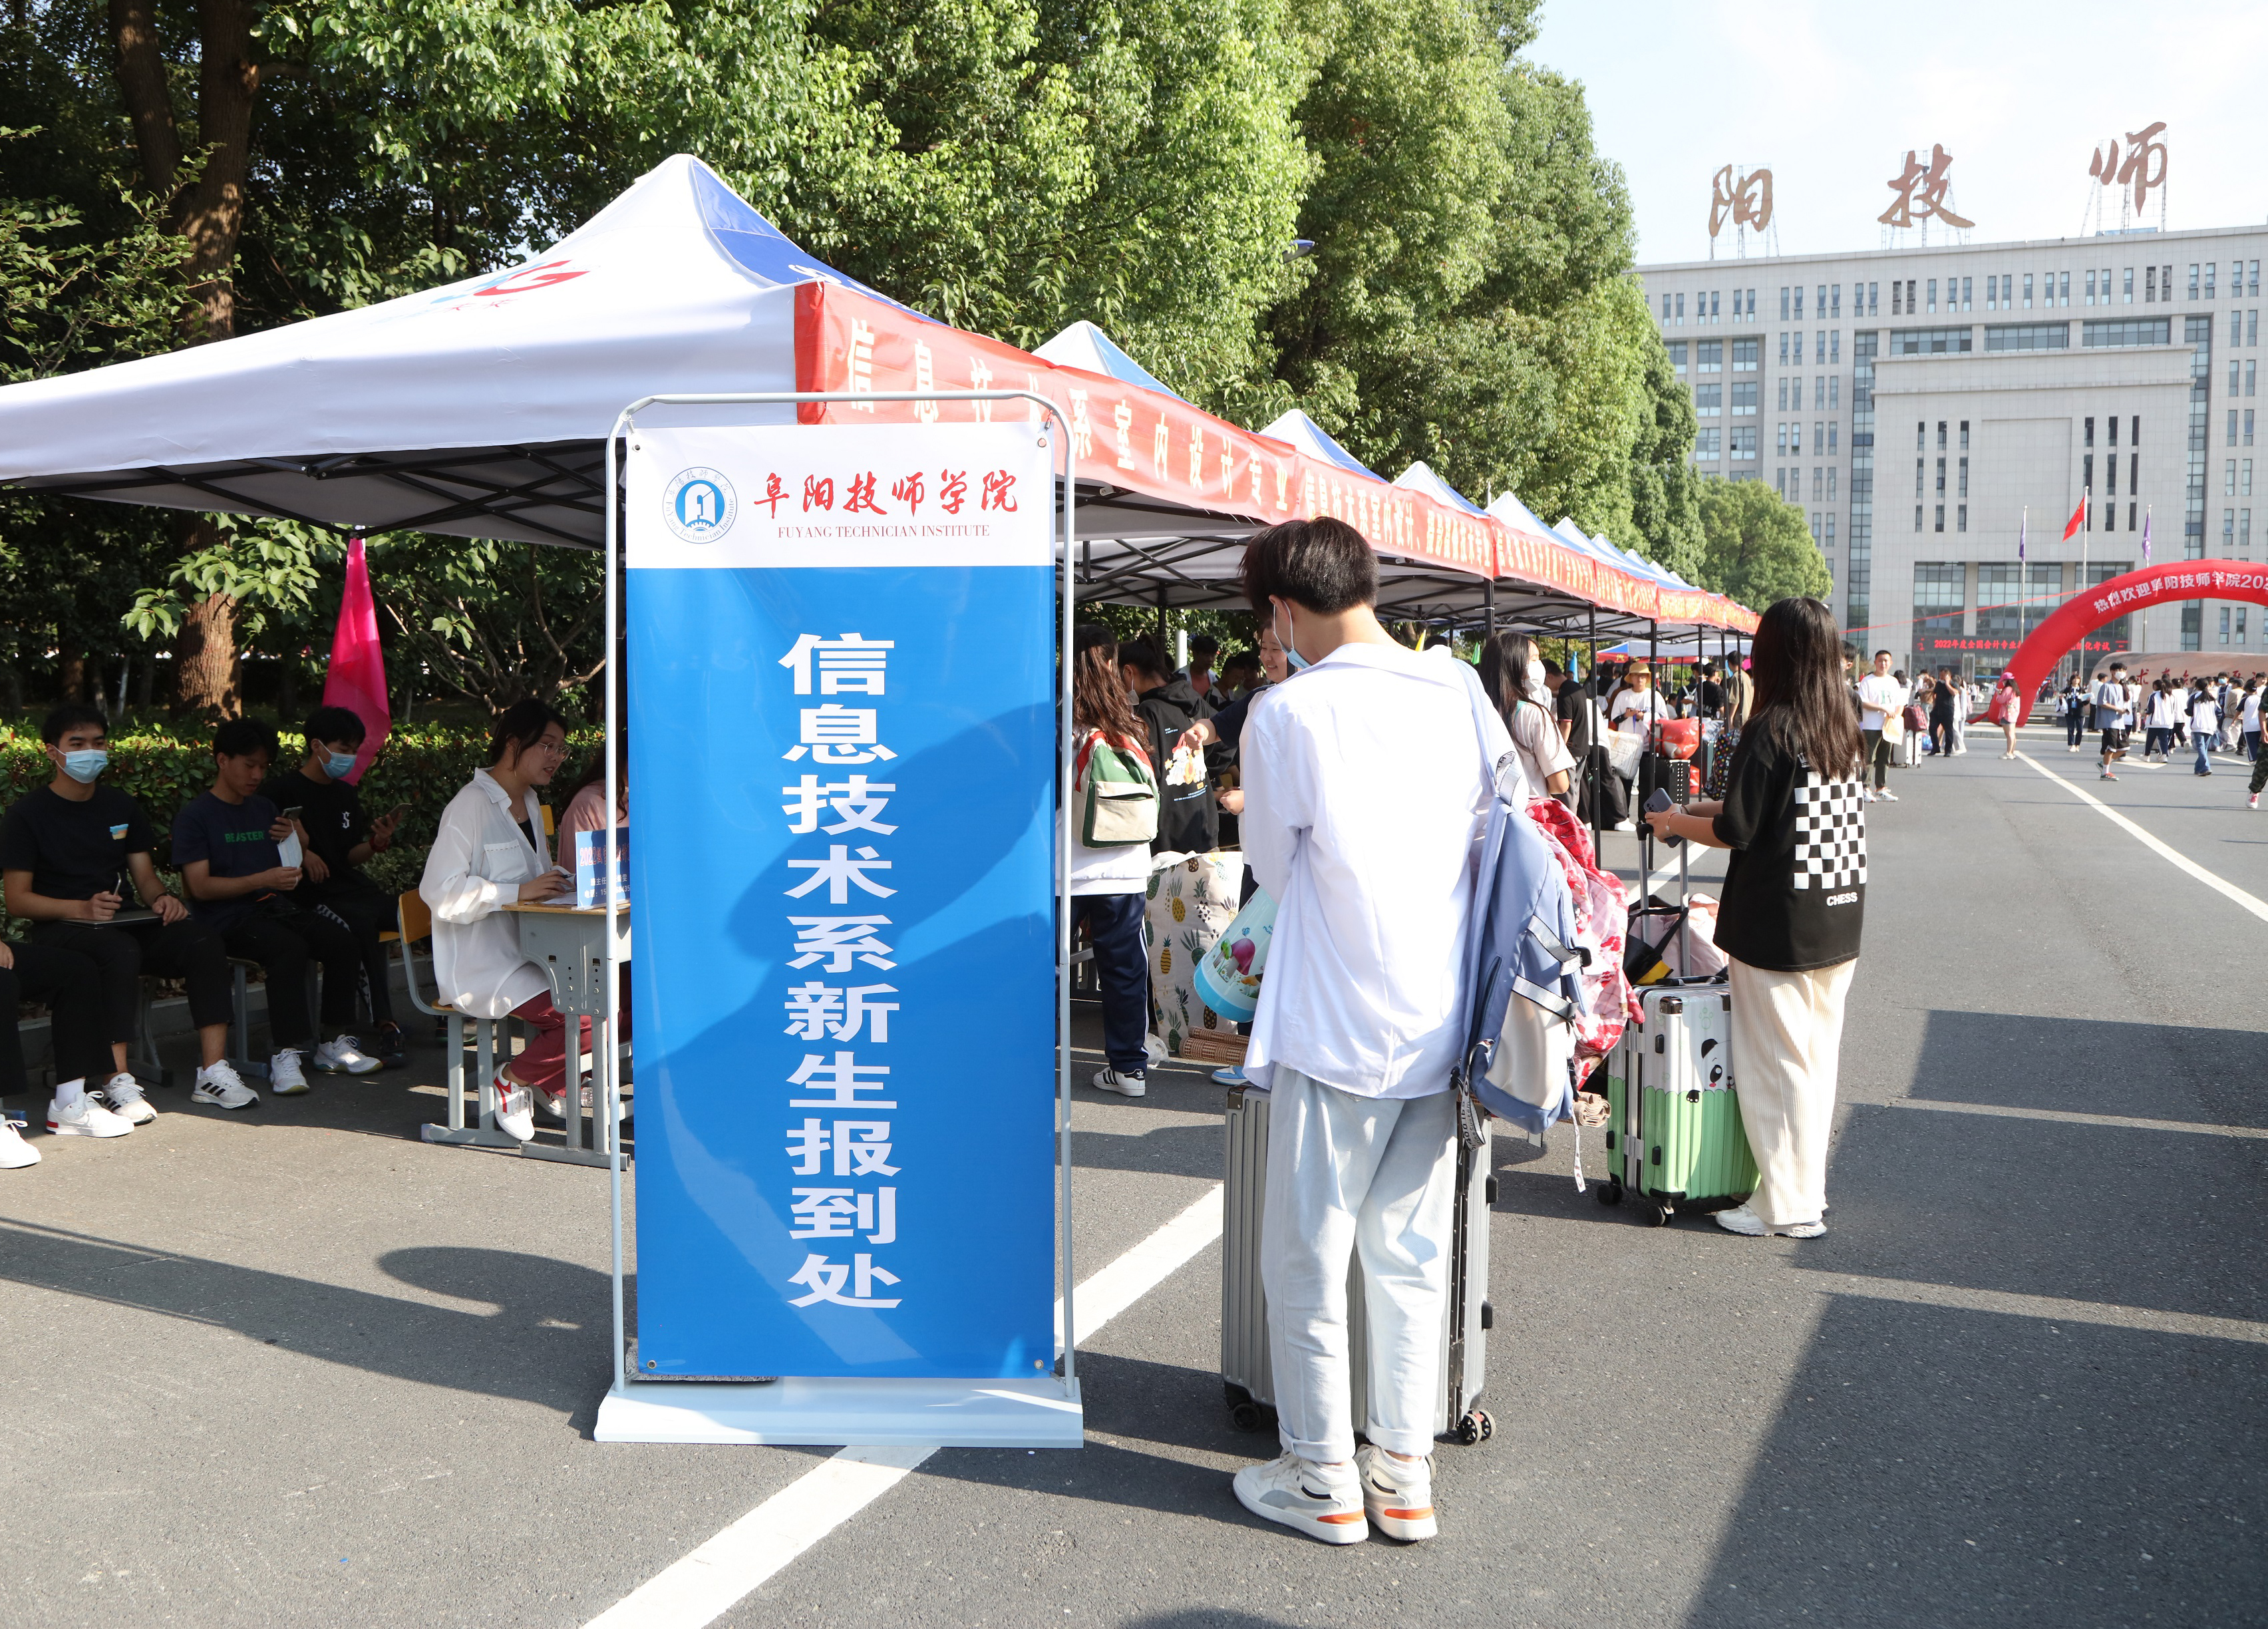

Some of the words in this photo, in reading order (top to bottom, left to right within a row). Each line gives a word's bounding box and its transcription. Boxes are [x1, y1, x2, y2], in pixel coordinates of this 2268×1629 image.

[754, 468, 1018, 519] 阜阳技师学院
[778, 526, 832, 538] FUYANG
[836, 526, 918, 537] TECHNICIAN
[921, 524, 990, 536] INSTITUTE
[1934, 639, 2021, 650] 2022年度全国会计专业
[224, 830, 265, 843] BEASTER
[1826, 892, 1858, 906] CHESS
[778, 632, 903, 1310] 信息技术系新生报到处
